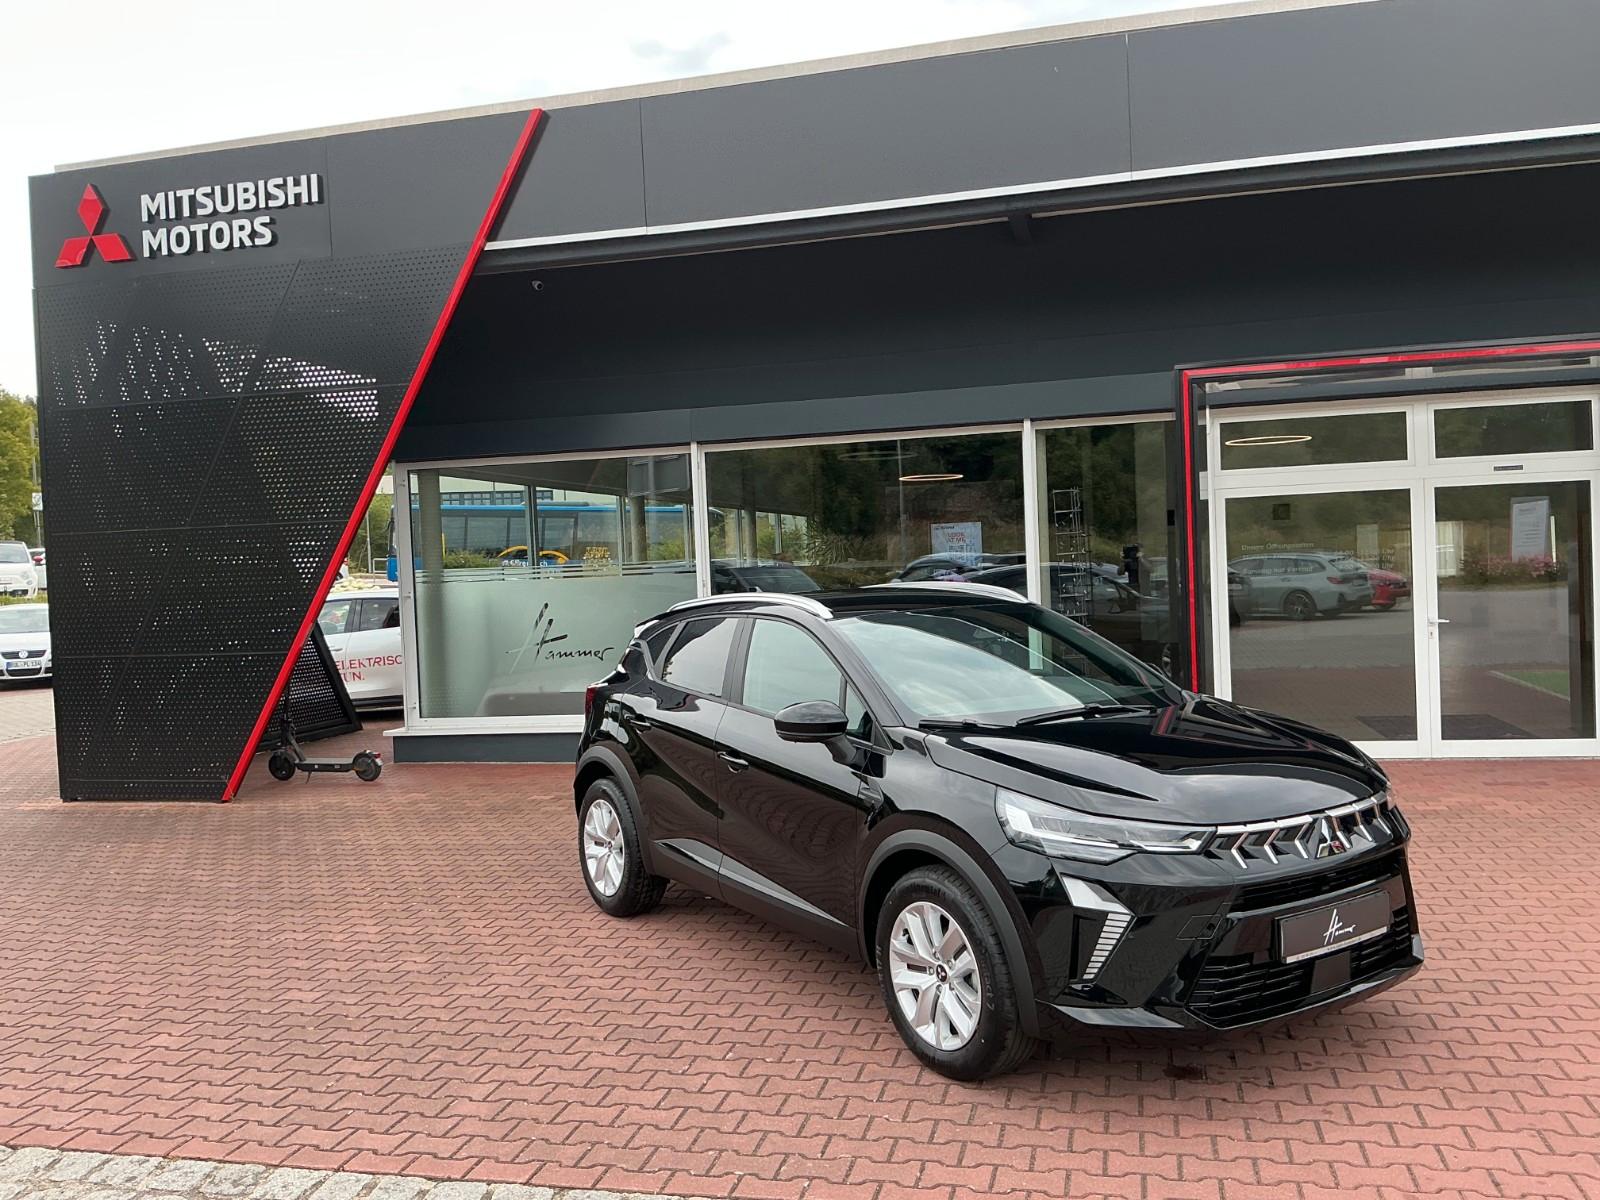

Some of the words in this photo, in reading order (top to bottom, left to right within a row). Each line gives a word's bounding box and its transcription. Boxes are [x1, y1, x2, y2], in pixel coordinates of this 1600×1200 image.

[140, 173, 319, 222] MITSUBISHI
[142, 216, 273, 258] MOTORS
[505, 602, 615, 675] Hammer
